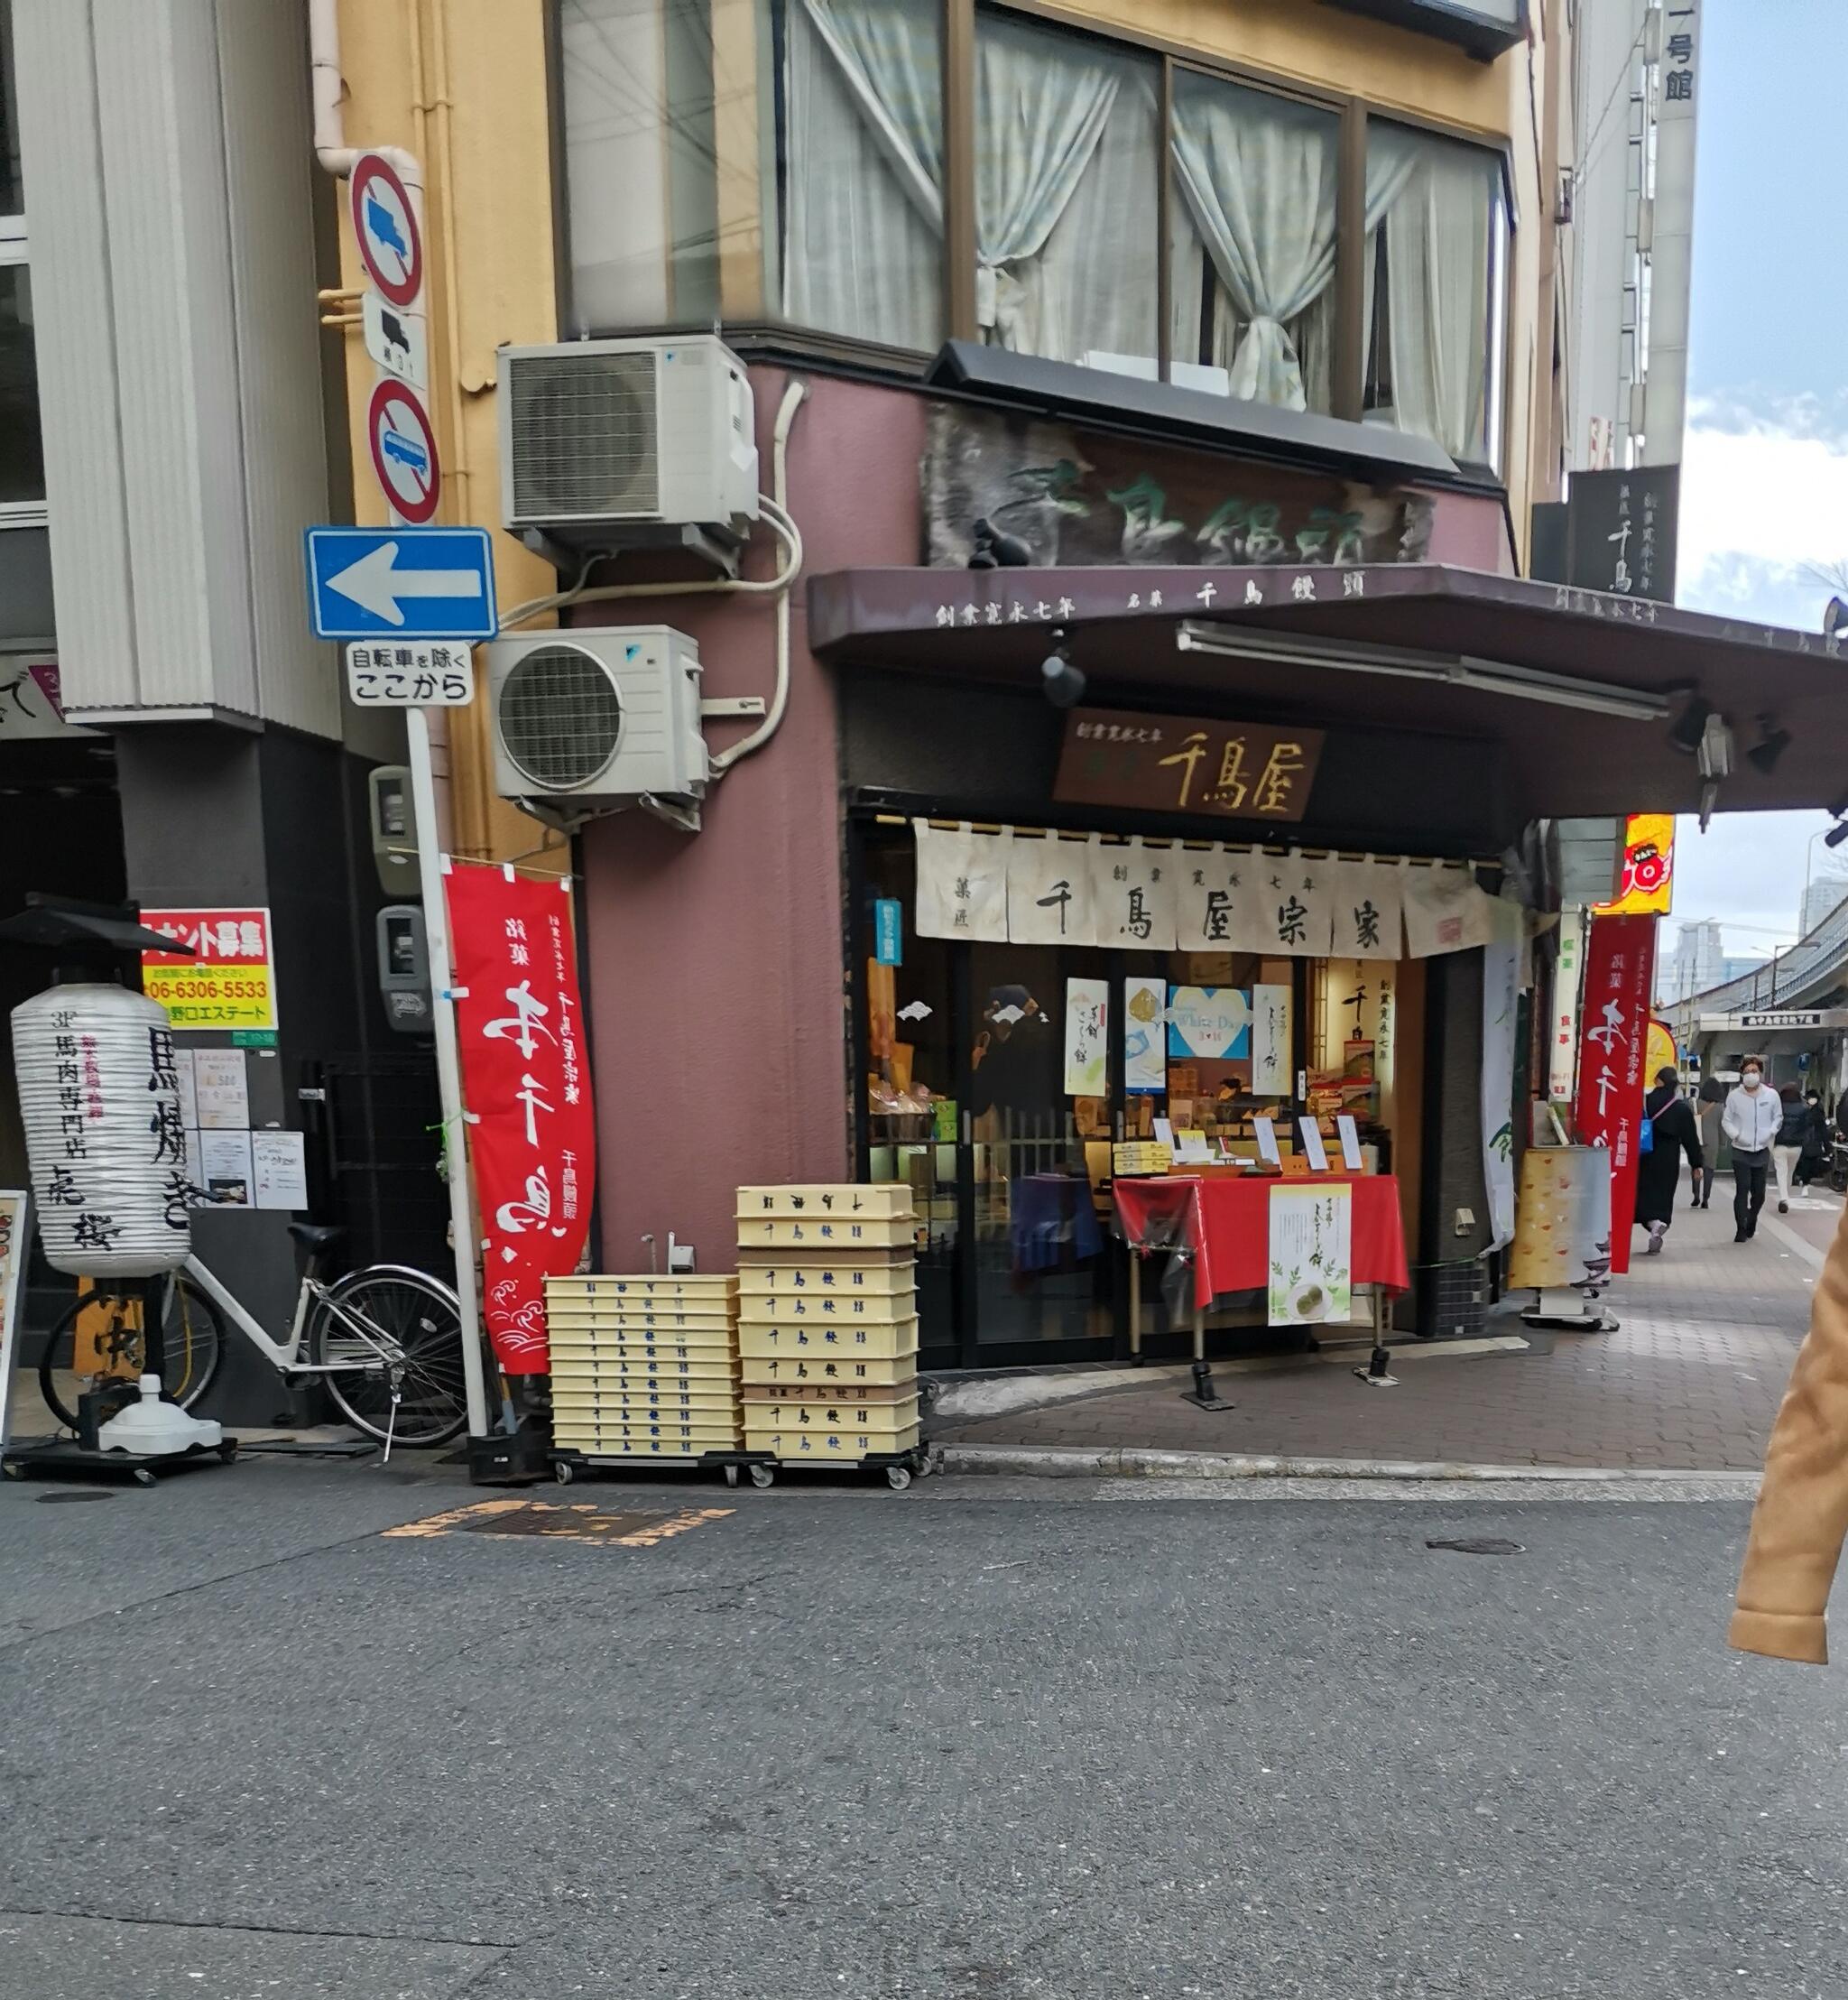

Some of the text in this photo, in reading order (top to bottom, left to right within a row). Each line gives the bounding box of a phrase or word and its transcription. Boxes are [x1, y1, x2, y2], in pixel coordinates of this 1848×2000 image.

[1666, 8, 1695, 100] 一号館
[1197, 569, 1365, 608] 千鳥饅頭
[936, 597, 1076, 626] 創業寛永七年
[353, 647, 465, 668] 自転車を除く
[356, 673, 467, 699] ここから
[1158, 732, 1305, 811] 千鳥屋
[1113, 865, 1317, 892] 創業寛永七年
[953, 877, 971, 929] 菓匠
[1036, 881, 1381, 949] 千鳥屋宗家
[150, 981, 267, 998] 06-6306-5533
[51, 1012, 78, 1028] 3F
[55, 1035, 87, 1159] 馬肉専門店
[766, 1271, 864, 1288] 千鳥饅頭
[766, 1298, 864, 1315] 千鳥饅頭
[769, 1329, 866, 1345] 千鳥饅頭
[768, 1361, 866, 1378] 千鳥饅頭
[771, 1407, 868, 1424] 千鳥饅頭
